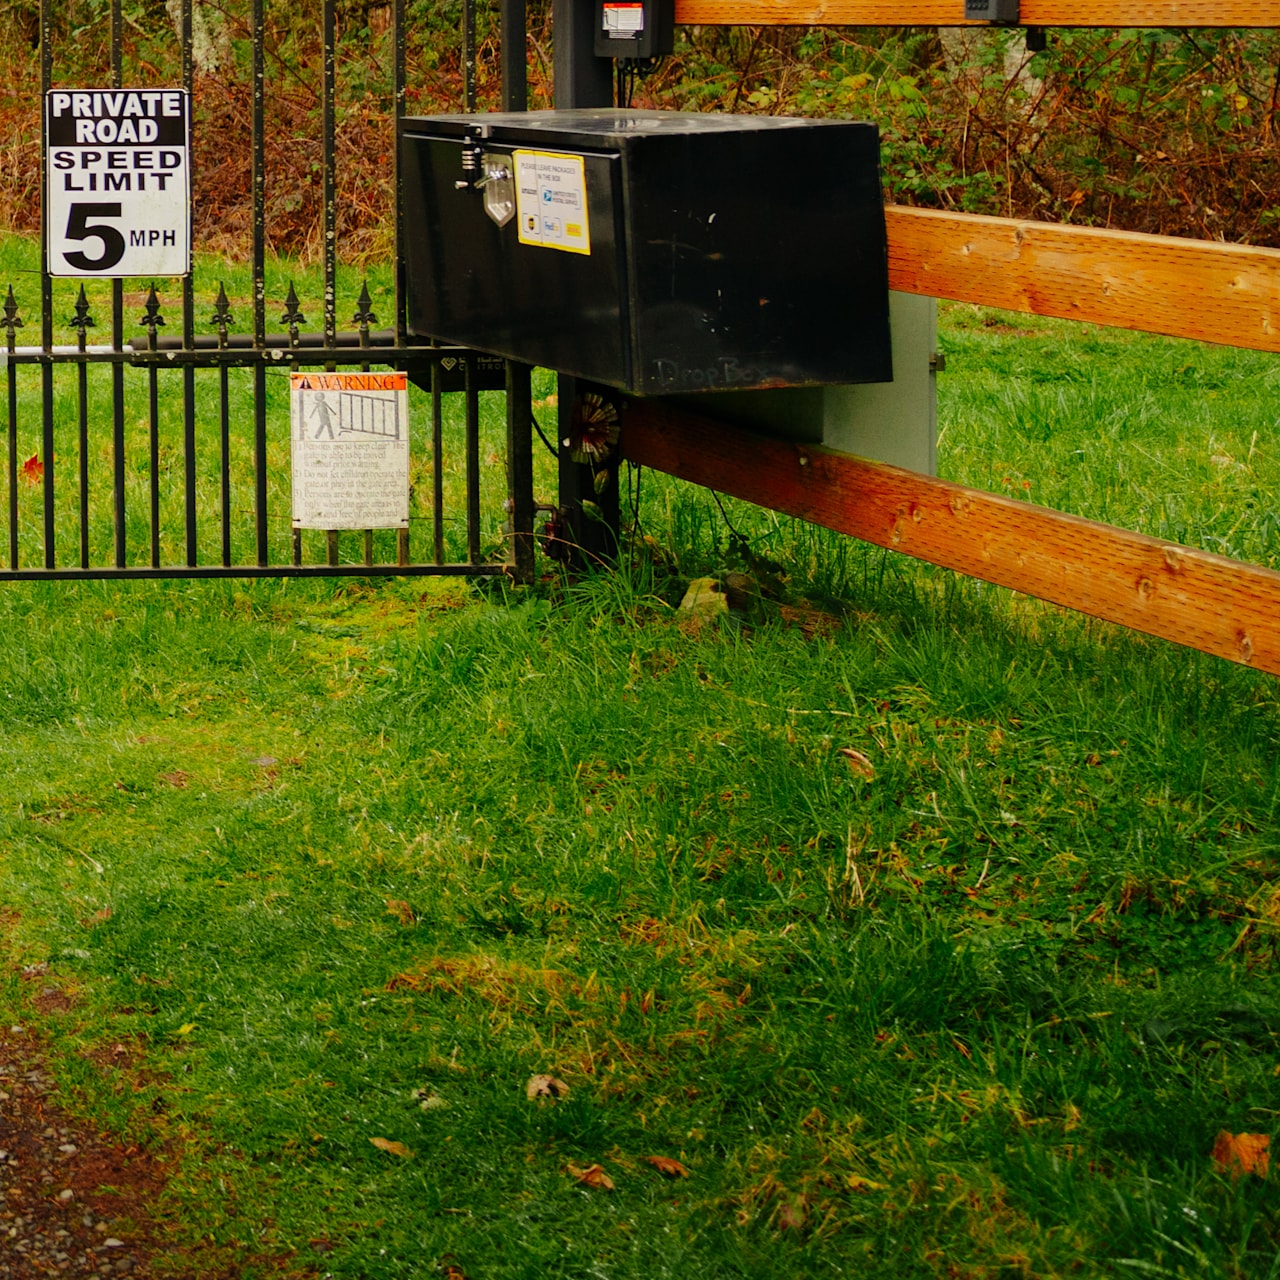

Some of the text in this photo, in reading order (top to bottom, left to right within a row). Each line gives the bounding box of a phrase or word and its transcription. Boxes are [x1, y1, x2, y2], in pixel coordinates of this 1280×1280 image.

[52, 93, 181, 117] PRIVATE
[76, 119, 159, 143] ROAD
[53, 151, 181, 170] SPEED
[552, 166, 575, 174] PACKAGES
[64, 173, 173, 191] LIMIT
[62, 202, 176, 271] 5 MPH
[318, 375, 396, 390] WARNING
